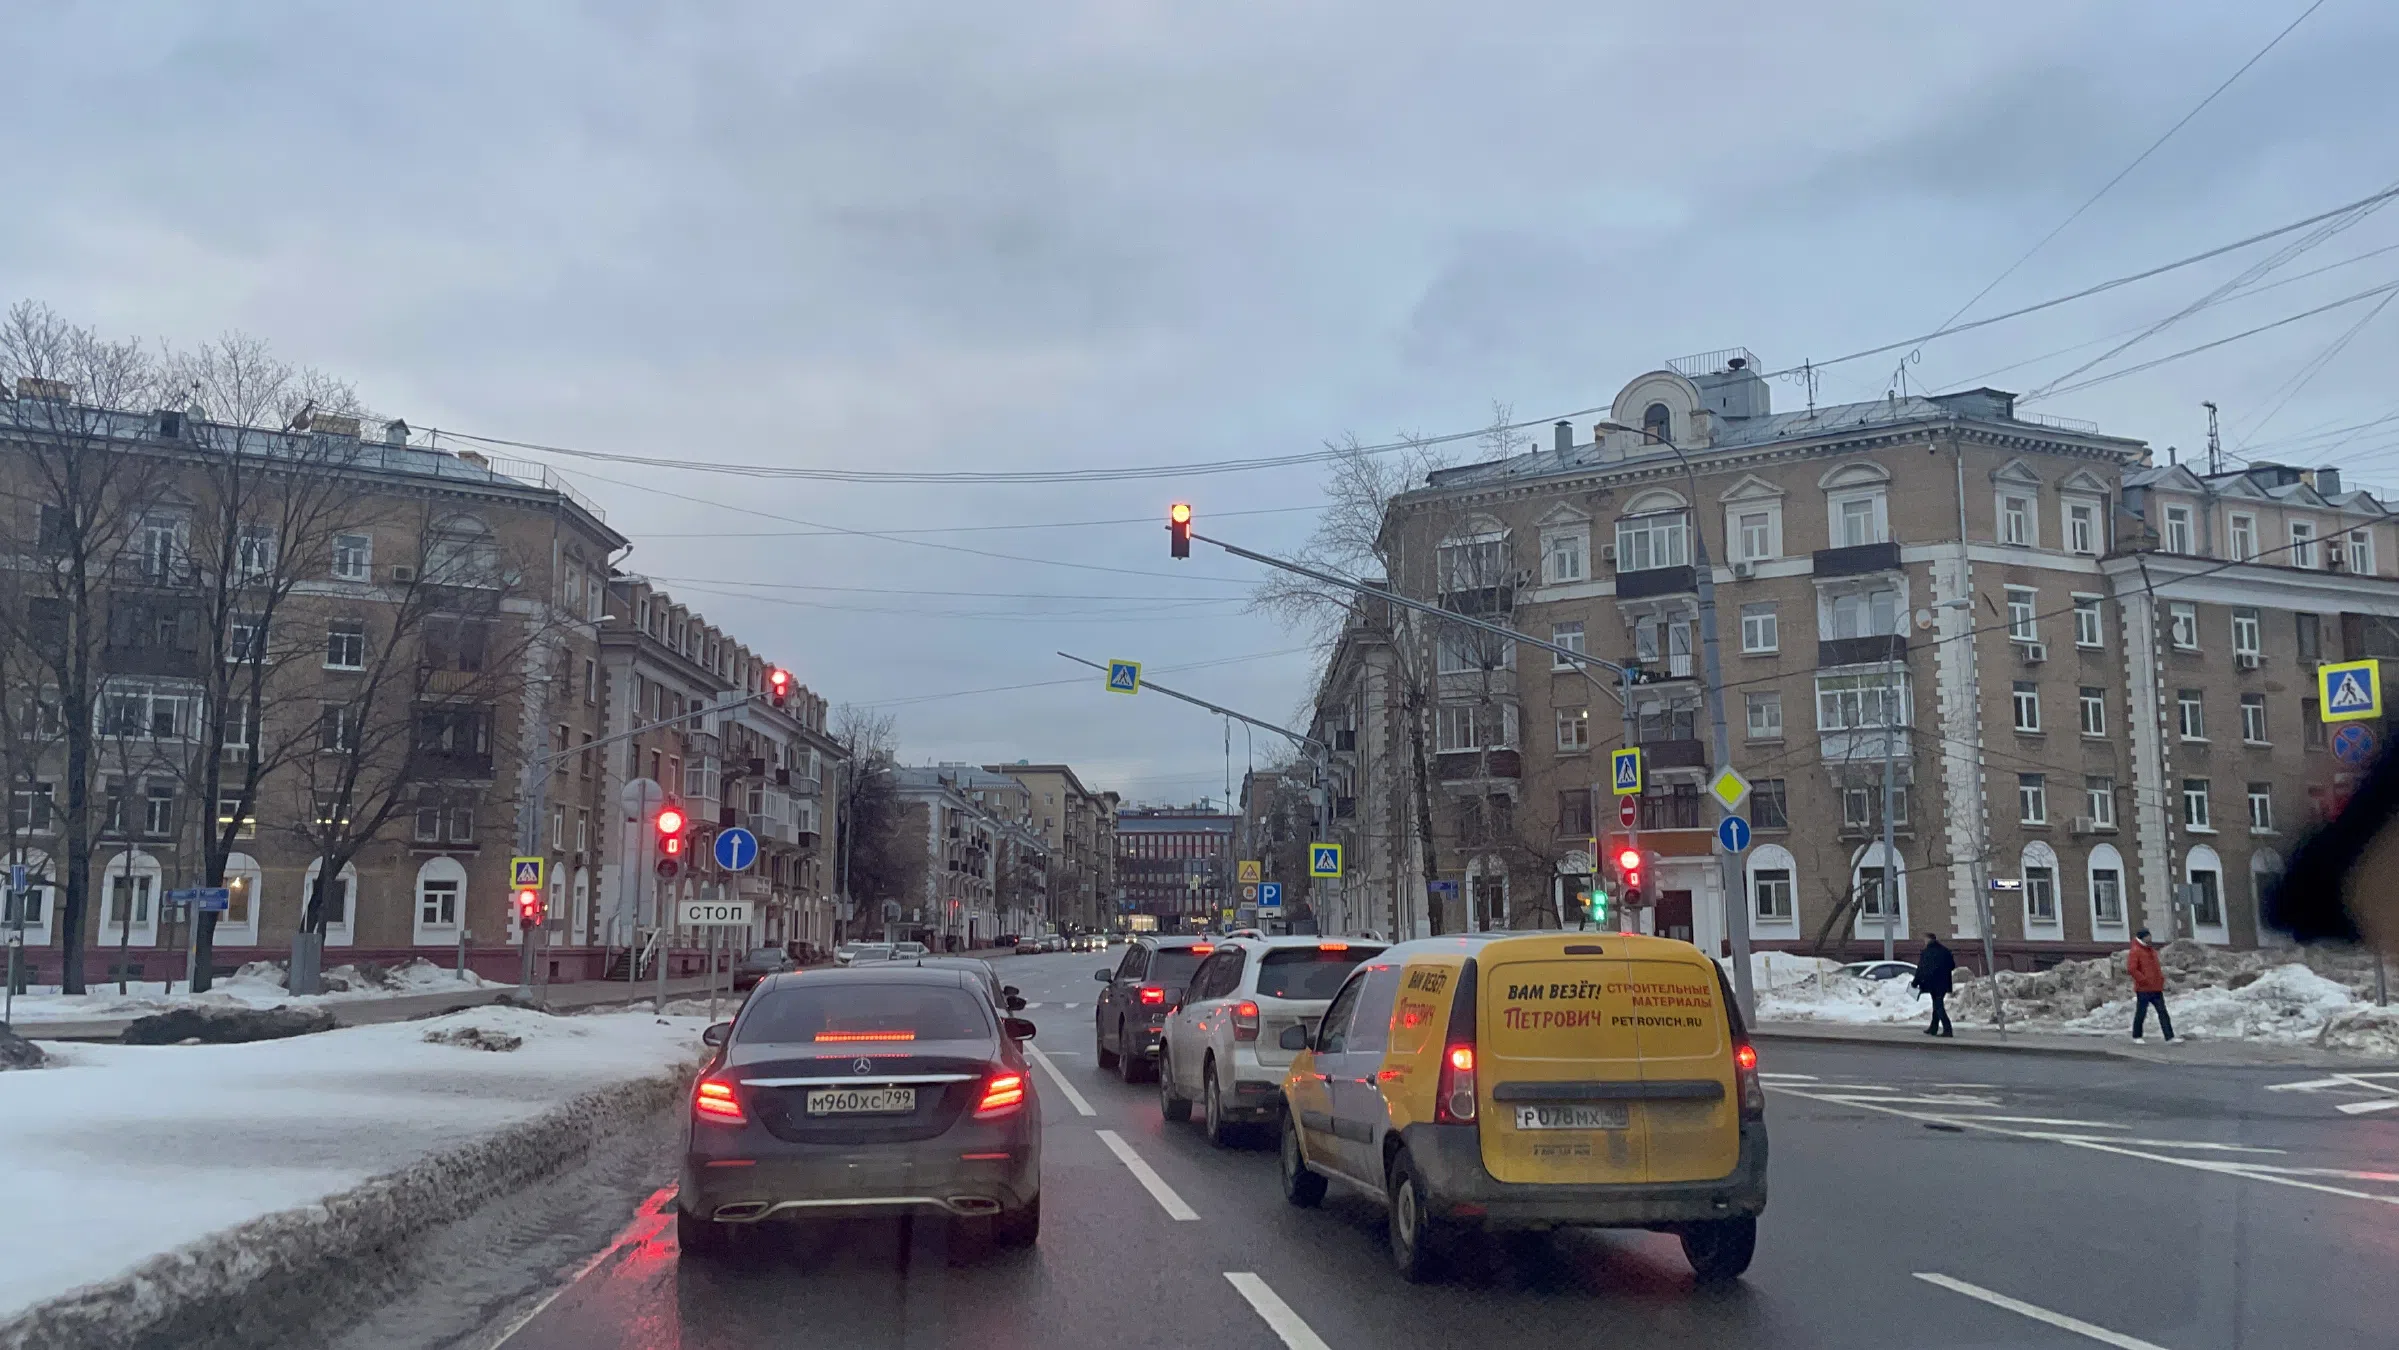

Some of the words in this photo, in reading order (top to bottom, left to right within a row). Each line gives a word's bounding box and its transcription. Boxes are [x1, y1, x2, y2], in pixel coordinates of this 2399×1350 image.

[689, 906, 742, 920] СТОП
[1508, 984, 1545, 1000] ВАМ
[1549, 980, 1602, 1000] ВЕЗЁТ!
[1606, 982, 1710, 995] СТРОИТЕЛЬНЫЕ
[1632, 996, 1712, 1008] МАТЕРИАЛЫ
[1611, 1016, 1703, 1028] PETROVICH.RU
[885, 1090, 911, 1104] 799
